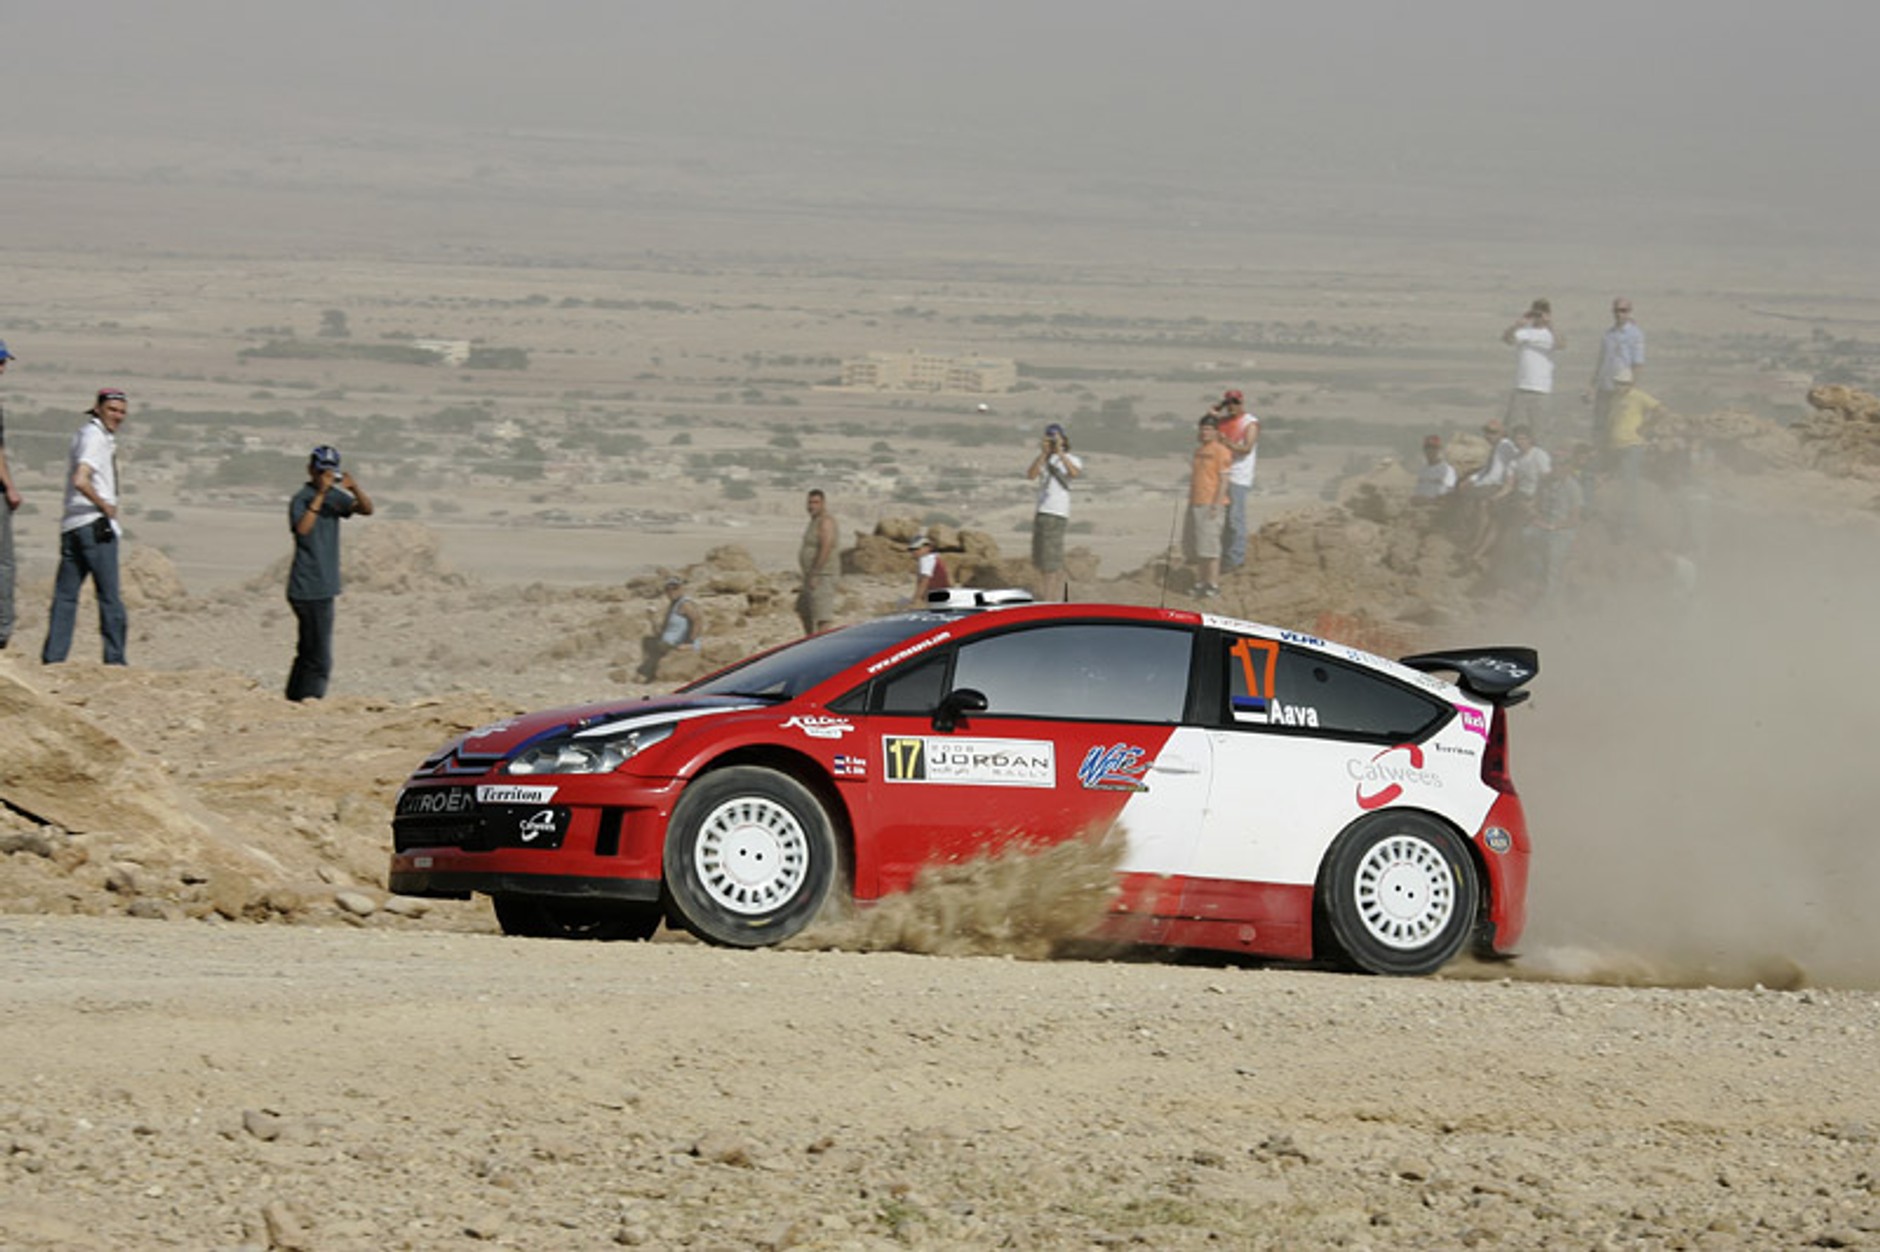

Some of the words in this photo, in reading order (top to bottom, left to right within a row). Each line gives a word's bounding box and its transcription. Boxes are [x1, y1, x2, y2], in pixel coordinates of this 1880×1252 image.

[1229, 637, 1280, 698] 17
[1269, 698, 1320, 728] Aava
[889, 738, 922, 780] 17
[931, 751, 1050, 769] JORDAN
